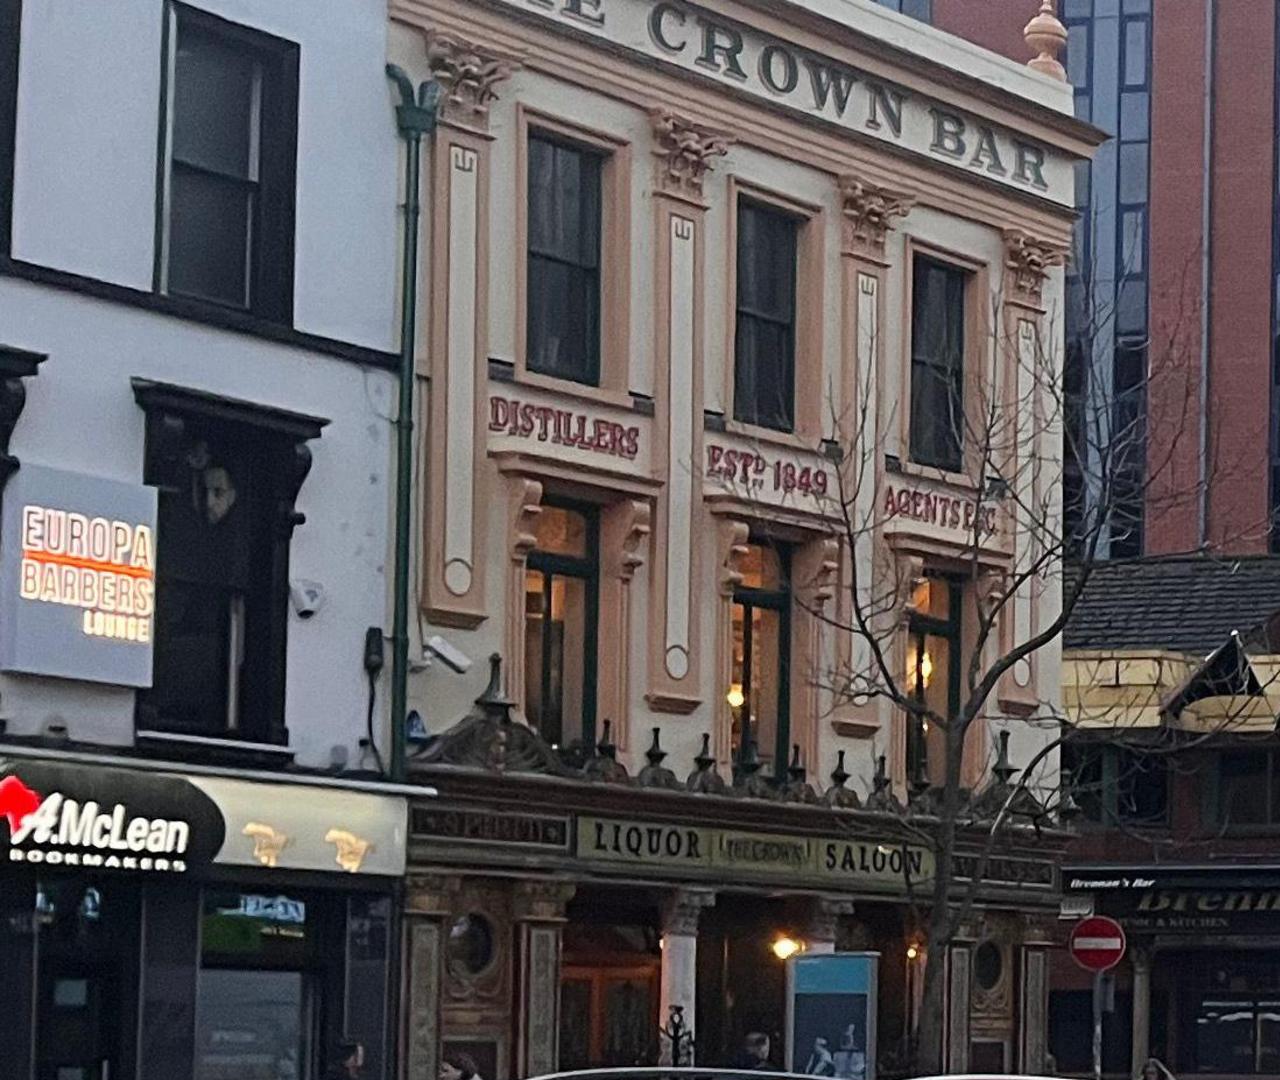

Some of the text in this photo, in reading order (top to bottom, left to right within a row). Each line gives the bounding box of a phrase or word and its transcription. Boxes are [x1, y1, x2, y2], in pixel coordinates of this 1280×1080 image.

[647, 1, 1050, 192] CROWN BAR
[488, 396, 640, 460] DISTILLERS
[773, 460, 829, 495] 1849
[884, 485, 961, 530] AGENTS
[22, 504, 152, 568] EUROPA
[20, 558, 154, 616] BARBERS
[83, 609, 151, 642] LOUNGE
[594, 821, 701, 859] LIQUOR
[9, 848, 187, 872] BOOKMAKERS
[825, 843, 923, 876] SALOON
[1132, 878, 1156, 888] Bar
